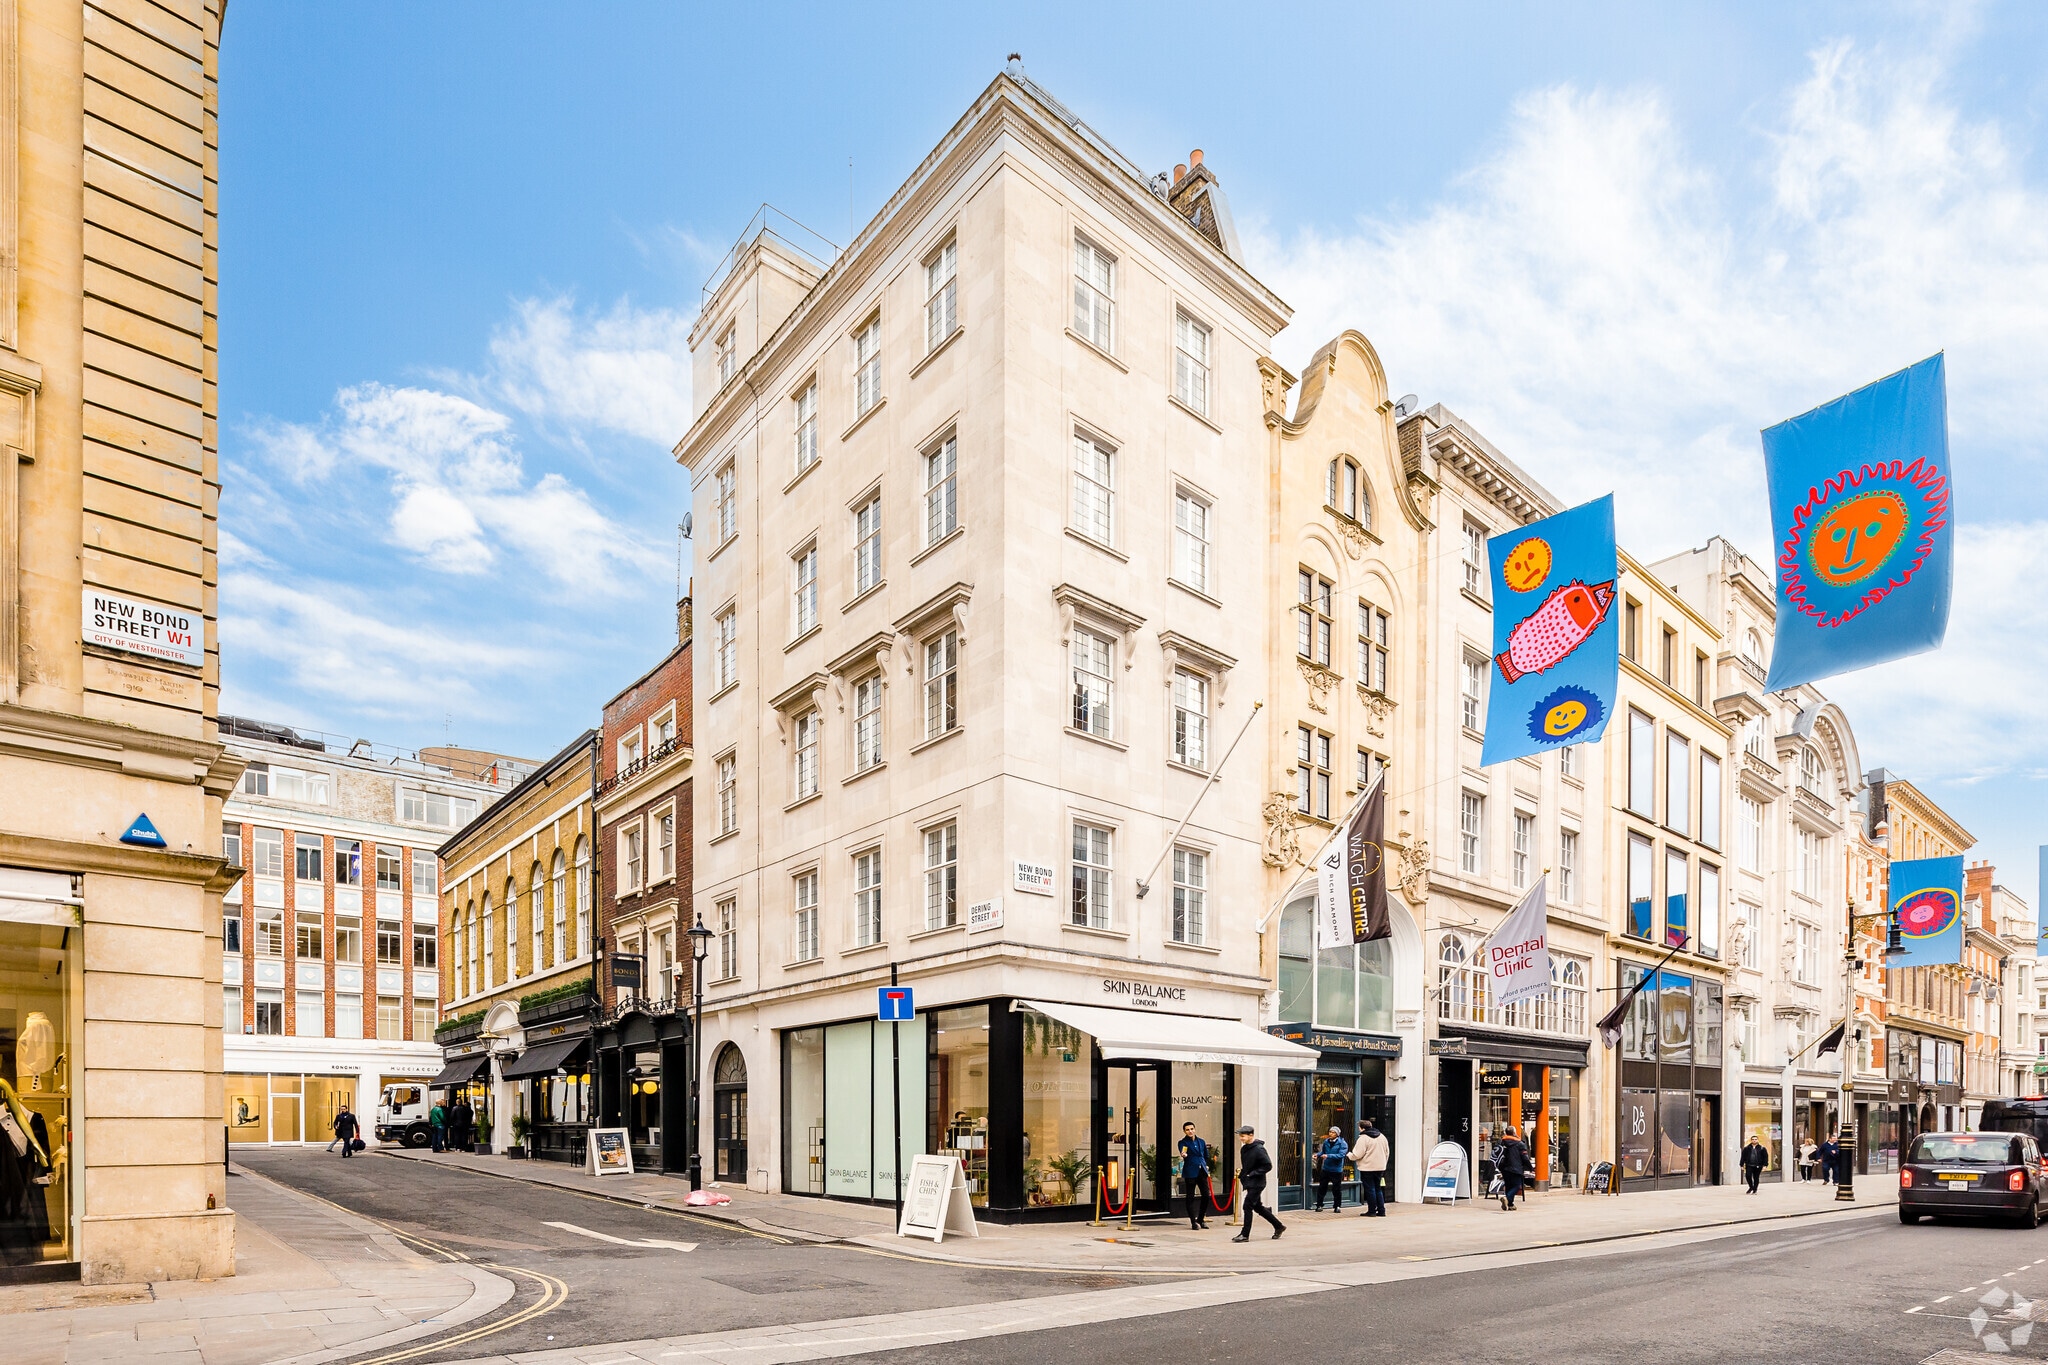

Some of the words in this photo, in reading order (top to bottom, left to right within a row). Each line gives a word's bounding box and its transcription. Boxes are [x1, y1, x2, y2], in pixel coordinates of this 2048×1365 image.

[94, 598, 134, 618] NEW
[142, 609, 189, 630] BOND
[94, 614, 160, 640] STREET
[167, 630, 192, 647] W1
[94, 634, 112, 644] CITY
[128, 642, 185, 660] WESTMINSTER
[131, 829, 157, 838] Chubb
[1018, 864, 1033, 873] NEW
[1035, 867, 1052, 877] BOND
[1018, 873, 1041, 884] STREET
[971, 902, 991, 915] DERING
[971, 912, 990, 923] STREET
[1329, 897, 1340, 942] DIAMONDS
[1491, 934, 1544, 962] Dental
[1494, 956, 1534, 978] Clinic
[1103, 980, 1130, 994] SKIN
[1134, 983, 1186, 1000] BALANCE
[1520, 982, 1548, 993] partners
[1132, 998, 1157, 1007] LONDON
[1316, 1035, 1321, 1045] &
[1355, 1038, 1362, 1048] of
[1363, 1040, 1380, 1050] Bond
[1381, 1042, 1400, 1051] Street
[1181, 1096, 1212, 1104] BALANC
[842, 1170, 868, 1178] BALANCE
[920, 1179, 934, 1187] FISH
[919, 1187, 937, 1195] CHIPS
